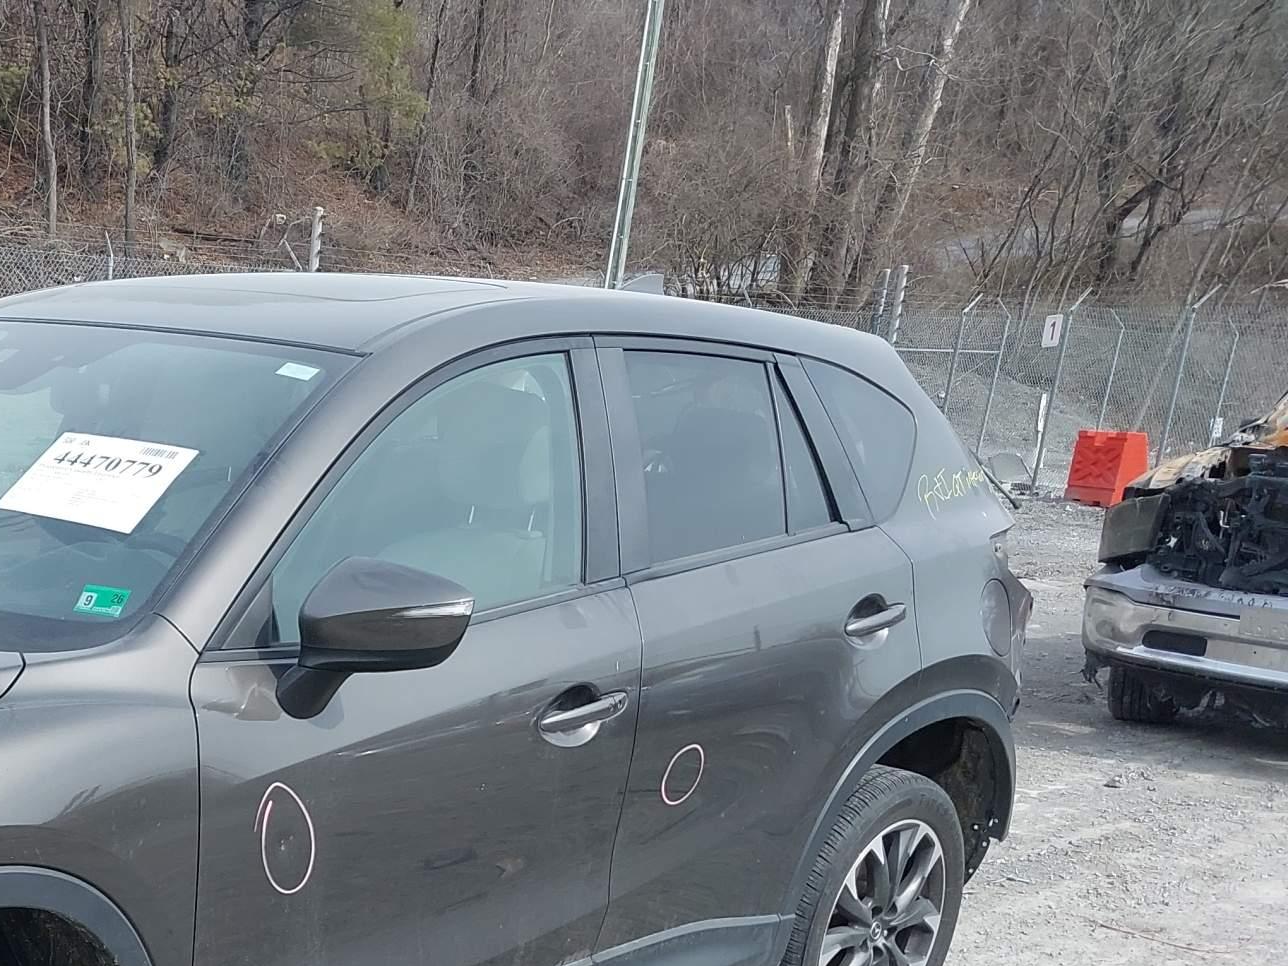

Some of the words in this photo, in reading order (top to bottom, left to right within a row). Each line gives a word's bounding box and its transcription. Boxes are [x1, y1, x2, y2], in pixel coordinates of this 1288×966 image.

[1049, 320, 1056, 341] 1
[54, 450, 163, 478] 44470779
[83, 594, 94, 606] 9
[111, 593, 125, 605] 26
